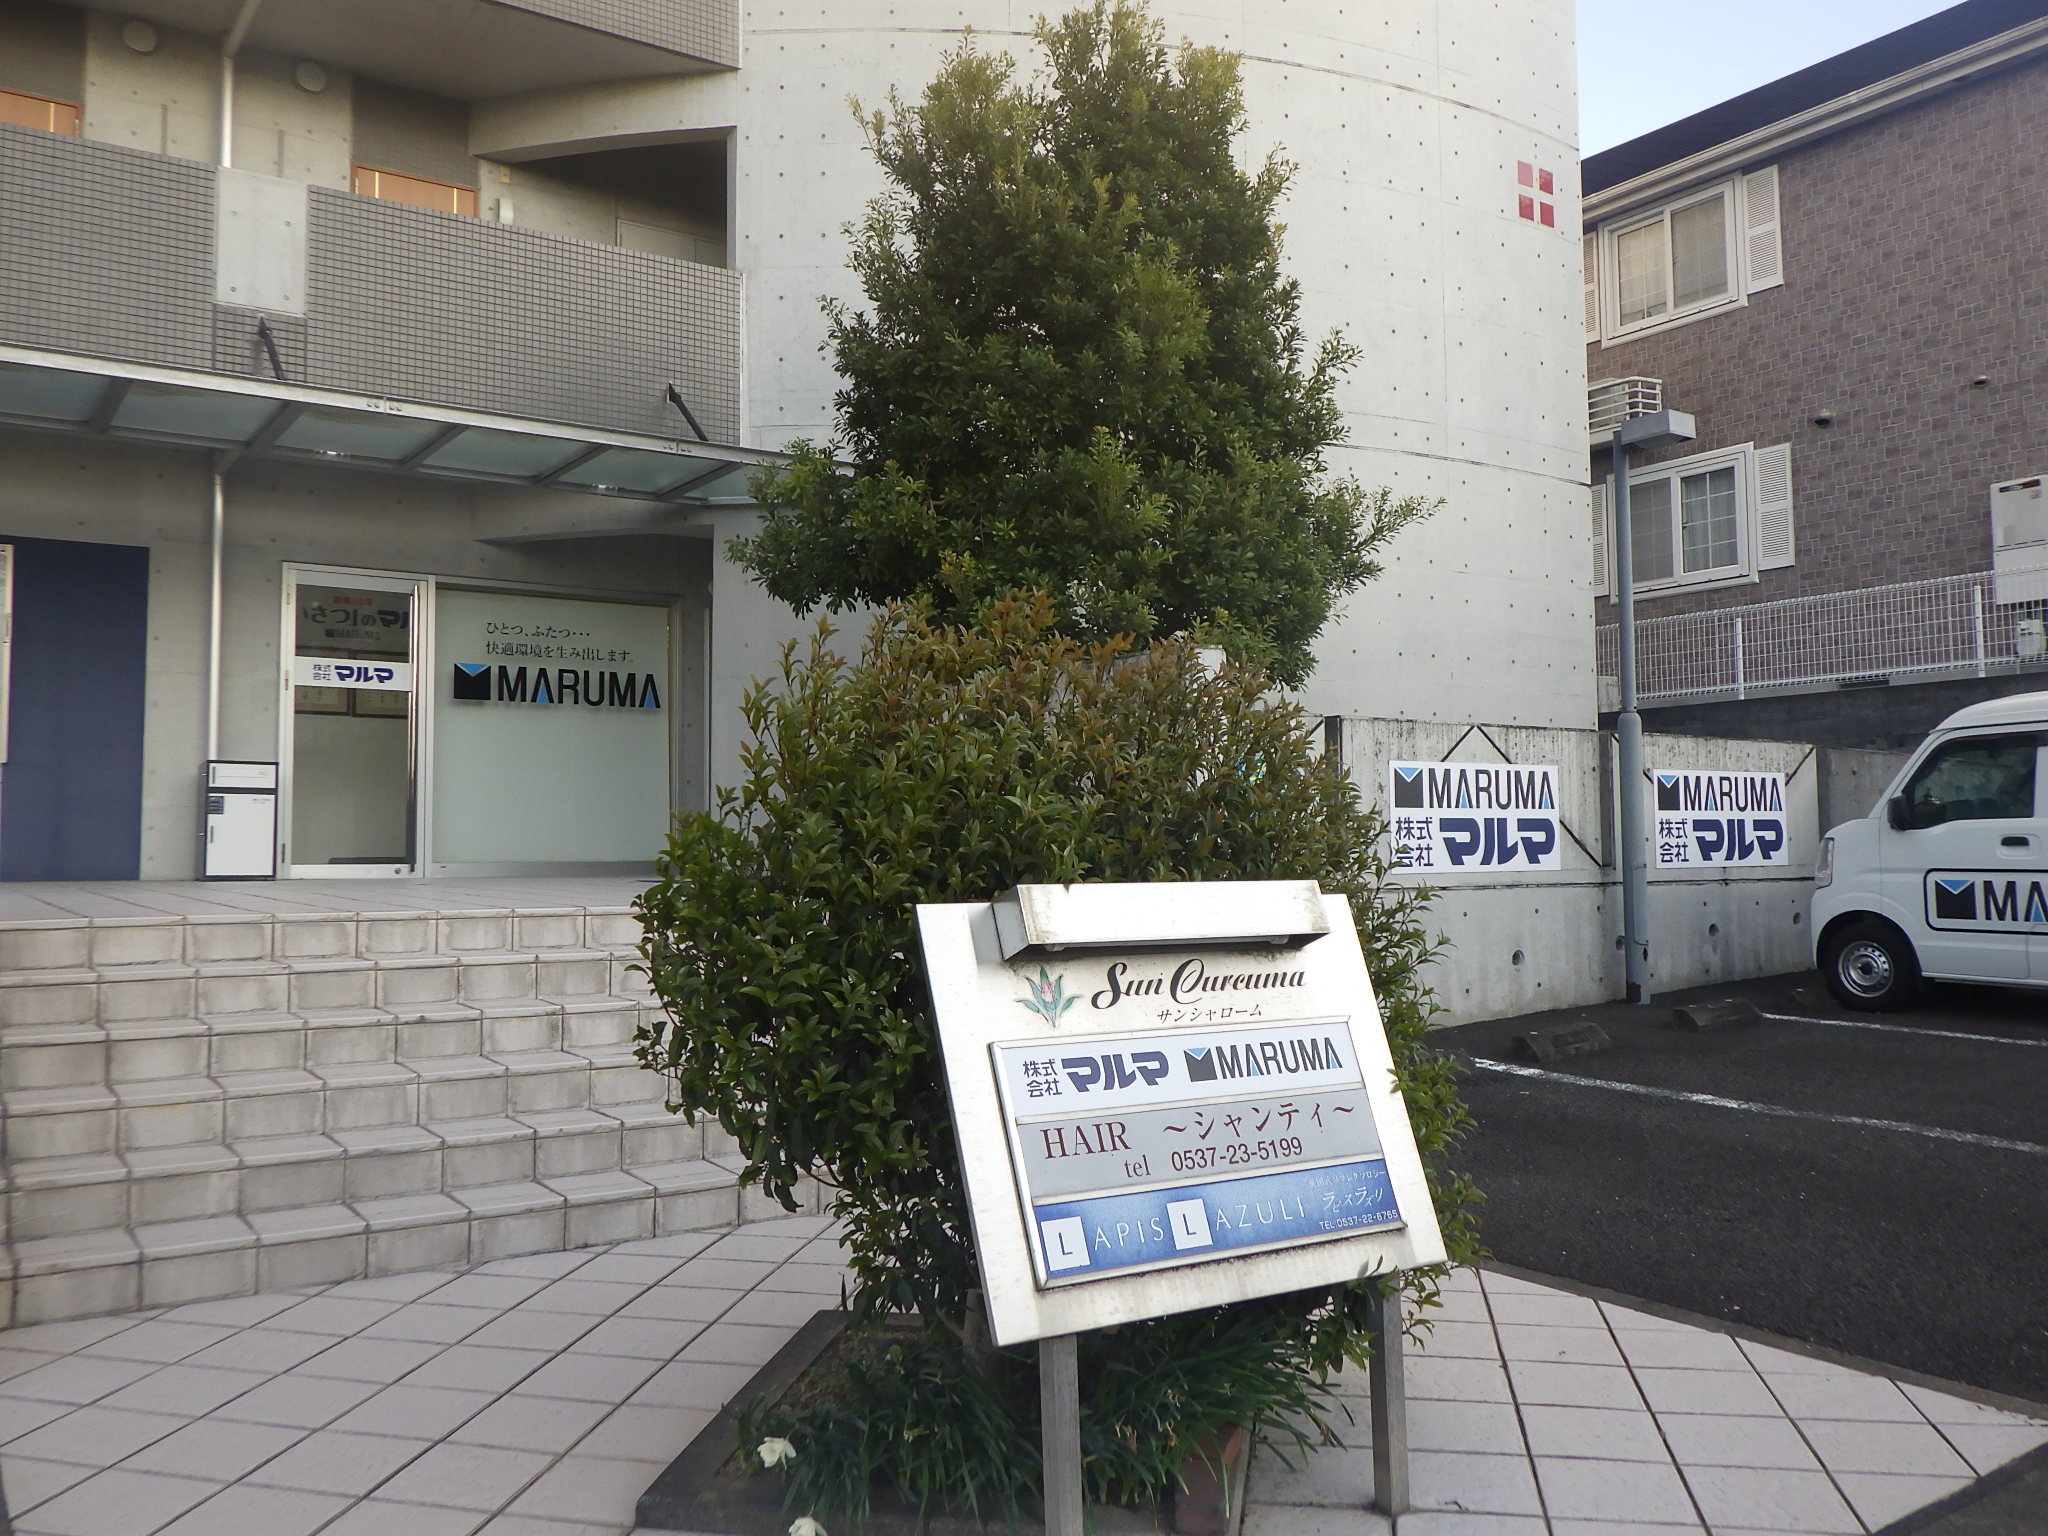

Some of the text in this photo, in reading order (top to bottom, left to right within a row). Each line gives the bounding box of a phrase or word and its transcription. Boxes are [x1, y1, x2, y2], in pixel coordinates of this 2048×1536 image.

[486, 641, 634, 664] 快適環境を生み出します。
[335, 665, 394, 683] マルマ
[498, 665, 661, 709] MARUMA
[1428, 768, 1556, 810] MARUMA
[1684, 775, 1783, 812] MARUMA
[1439, 817, 1556, 866] マルマ
[1659, 818, 1783, 861] 株式 マルマ
[1660, 841, 1689, 862] 会社
[1157, 1003, 1262, 1024] サンシャローム
[1023, 1050, 1169, 1093] 株式 マルマ
[1215, 1037, 1343, 1080] MARUMA
[1027, 1077, 1062, 1098] 会社
[1040, 1121, 1132, 1160] HAIR
[1124, 1136, 1304, 1178] tel 0537-23-5199
